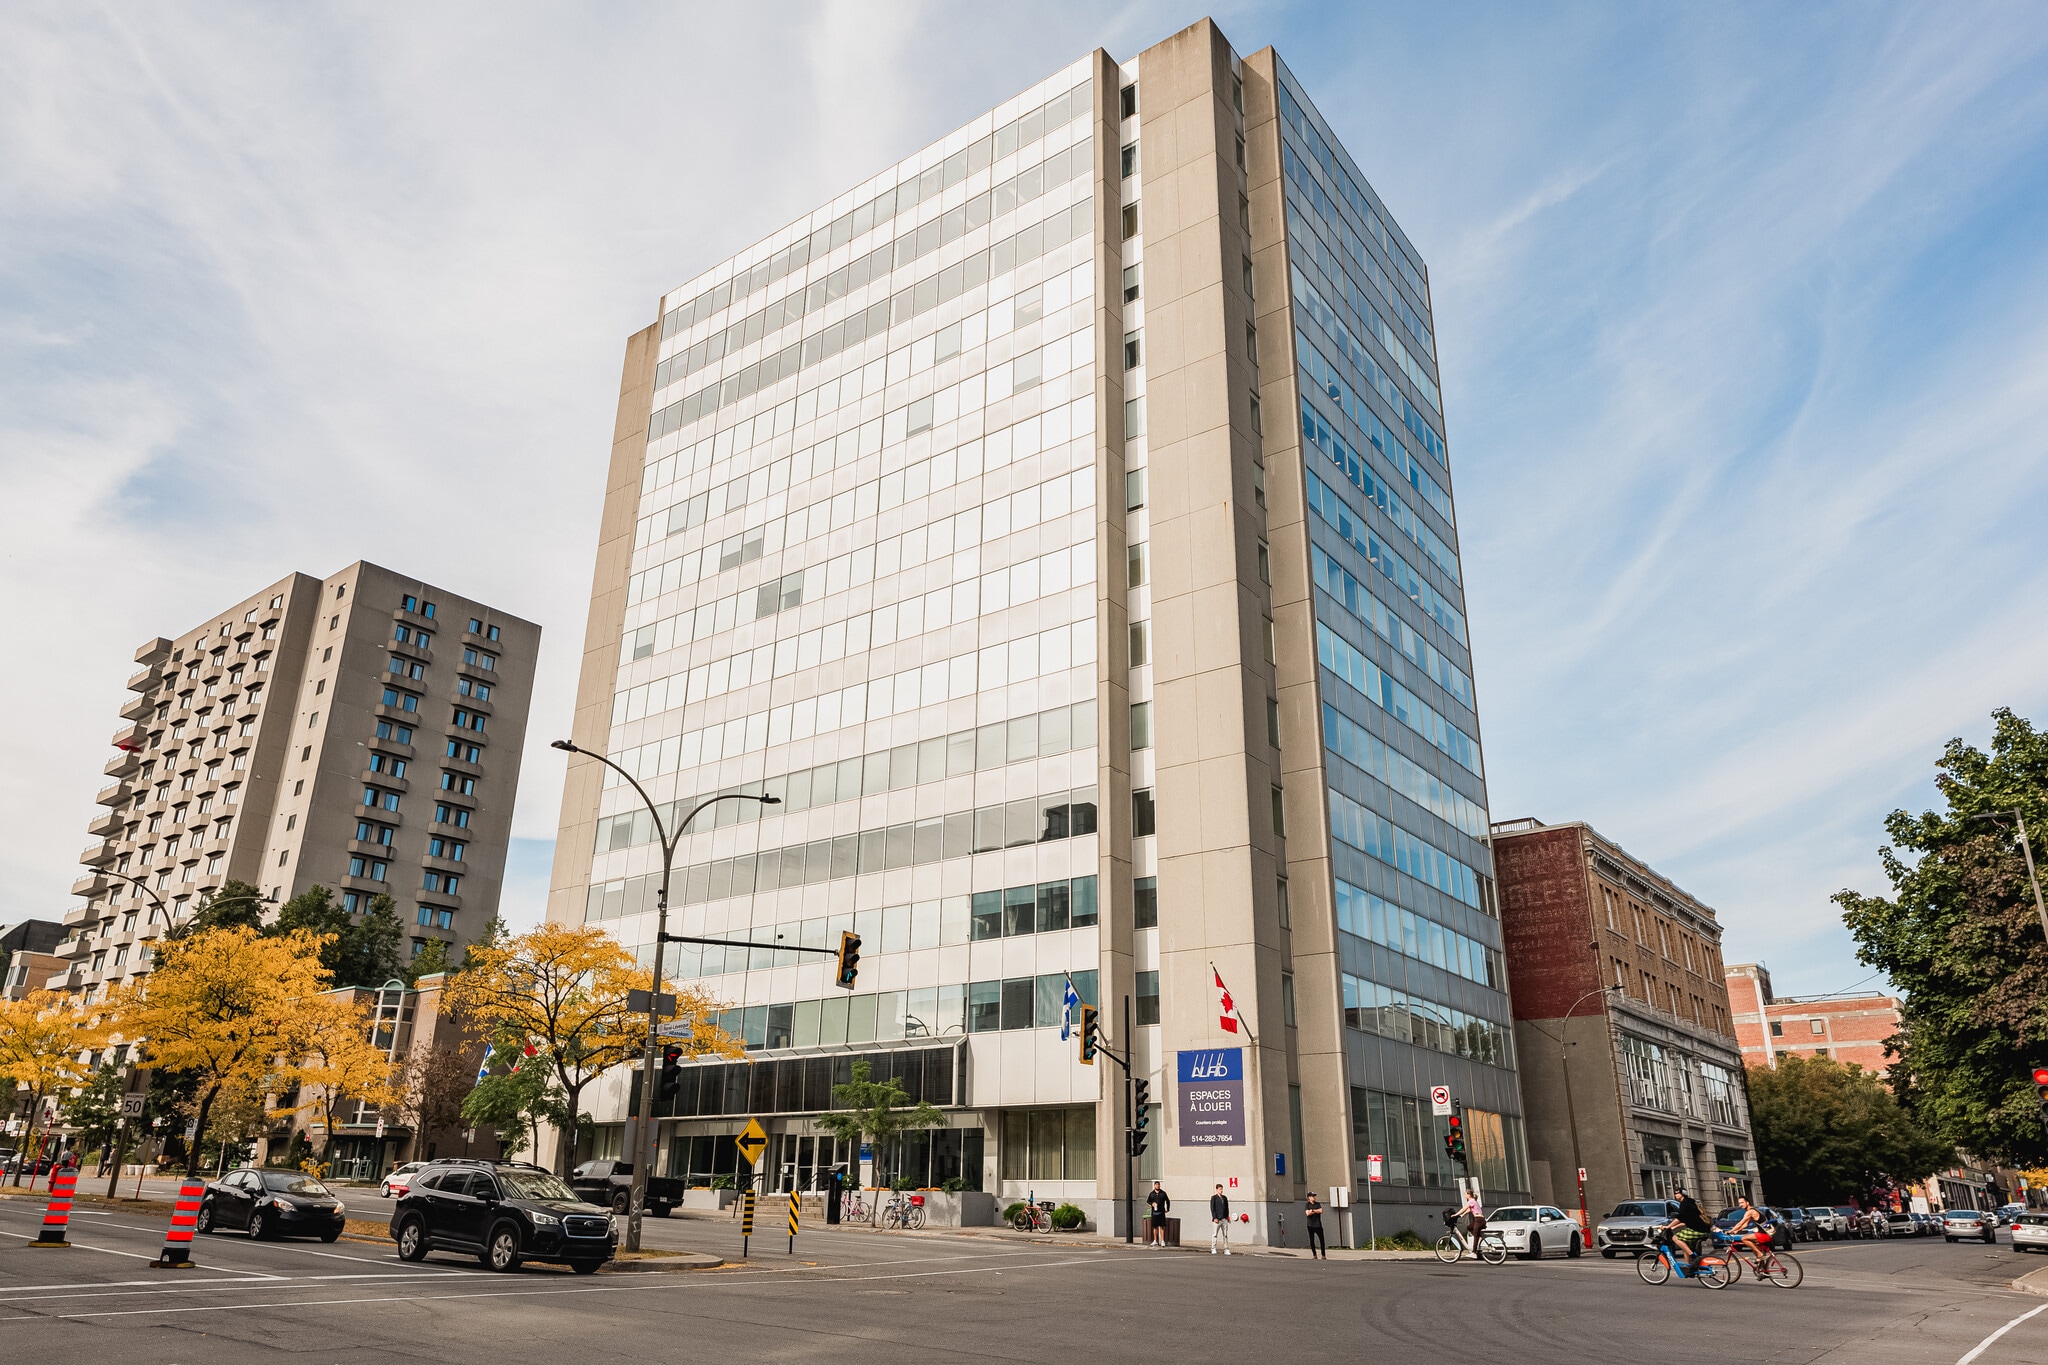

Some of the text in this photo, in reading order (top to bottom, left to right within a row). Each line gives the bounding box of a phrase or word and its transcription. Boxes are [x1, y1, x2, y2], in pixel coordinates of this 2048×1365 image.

[1189, 1090, 1231, 1101] ESPACES
[124, 1100, 142, 1113] 50
[1190, 1101, 1232, 1112] À LOUER
